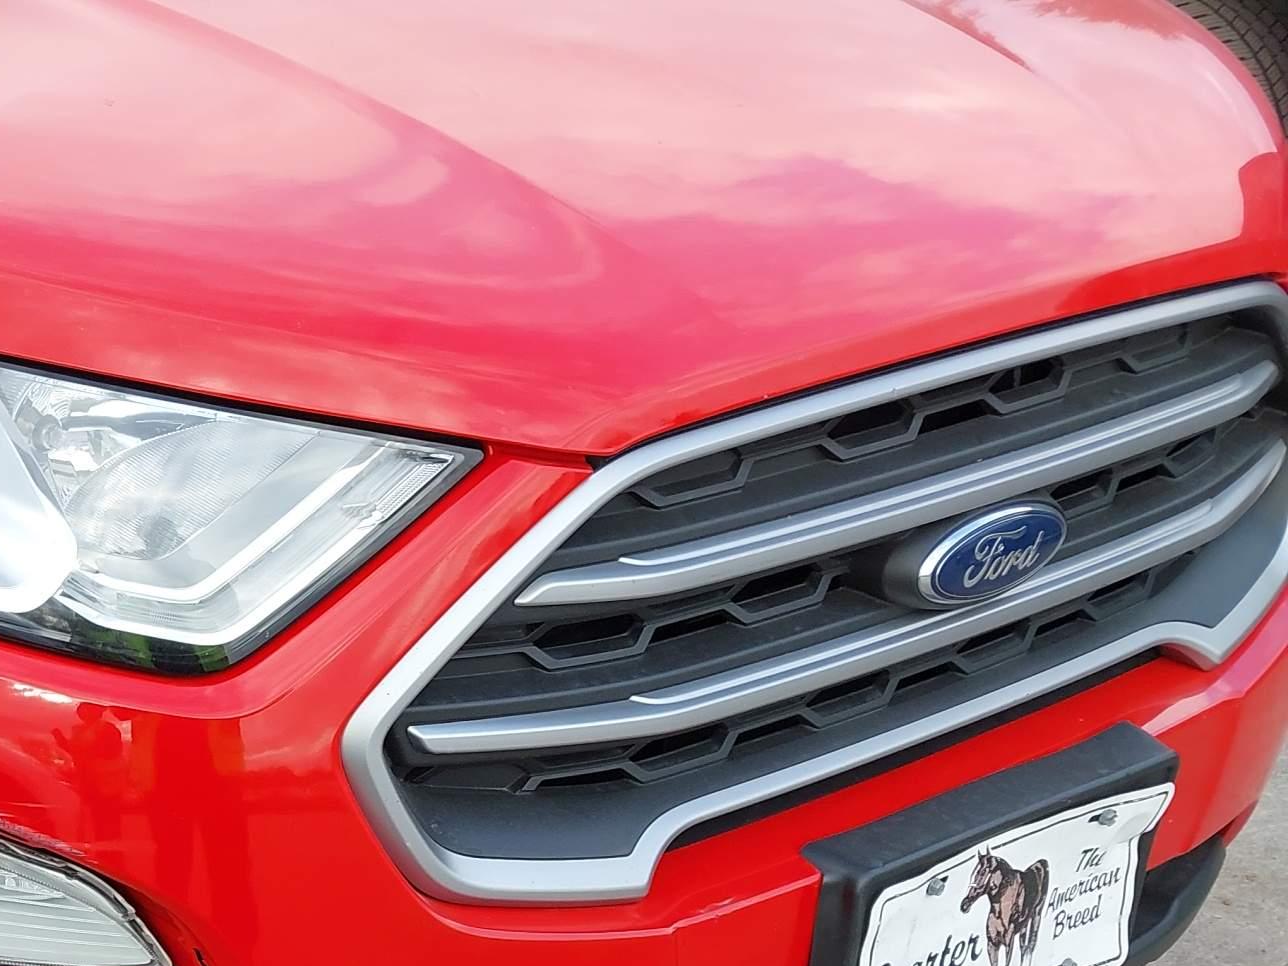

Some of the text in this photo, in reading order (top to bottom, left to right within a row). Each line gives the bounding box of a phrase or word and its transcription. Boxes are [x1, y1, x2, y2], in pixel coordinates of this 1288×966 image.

[963, 526, 1045, 588] Ford
[1075, 847, 1108, 873] The
[1046, 867, 1120, 917] American
[1053, 904, 1102, 940] Breed
